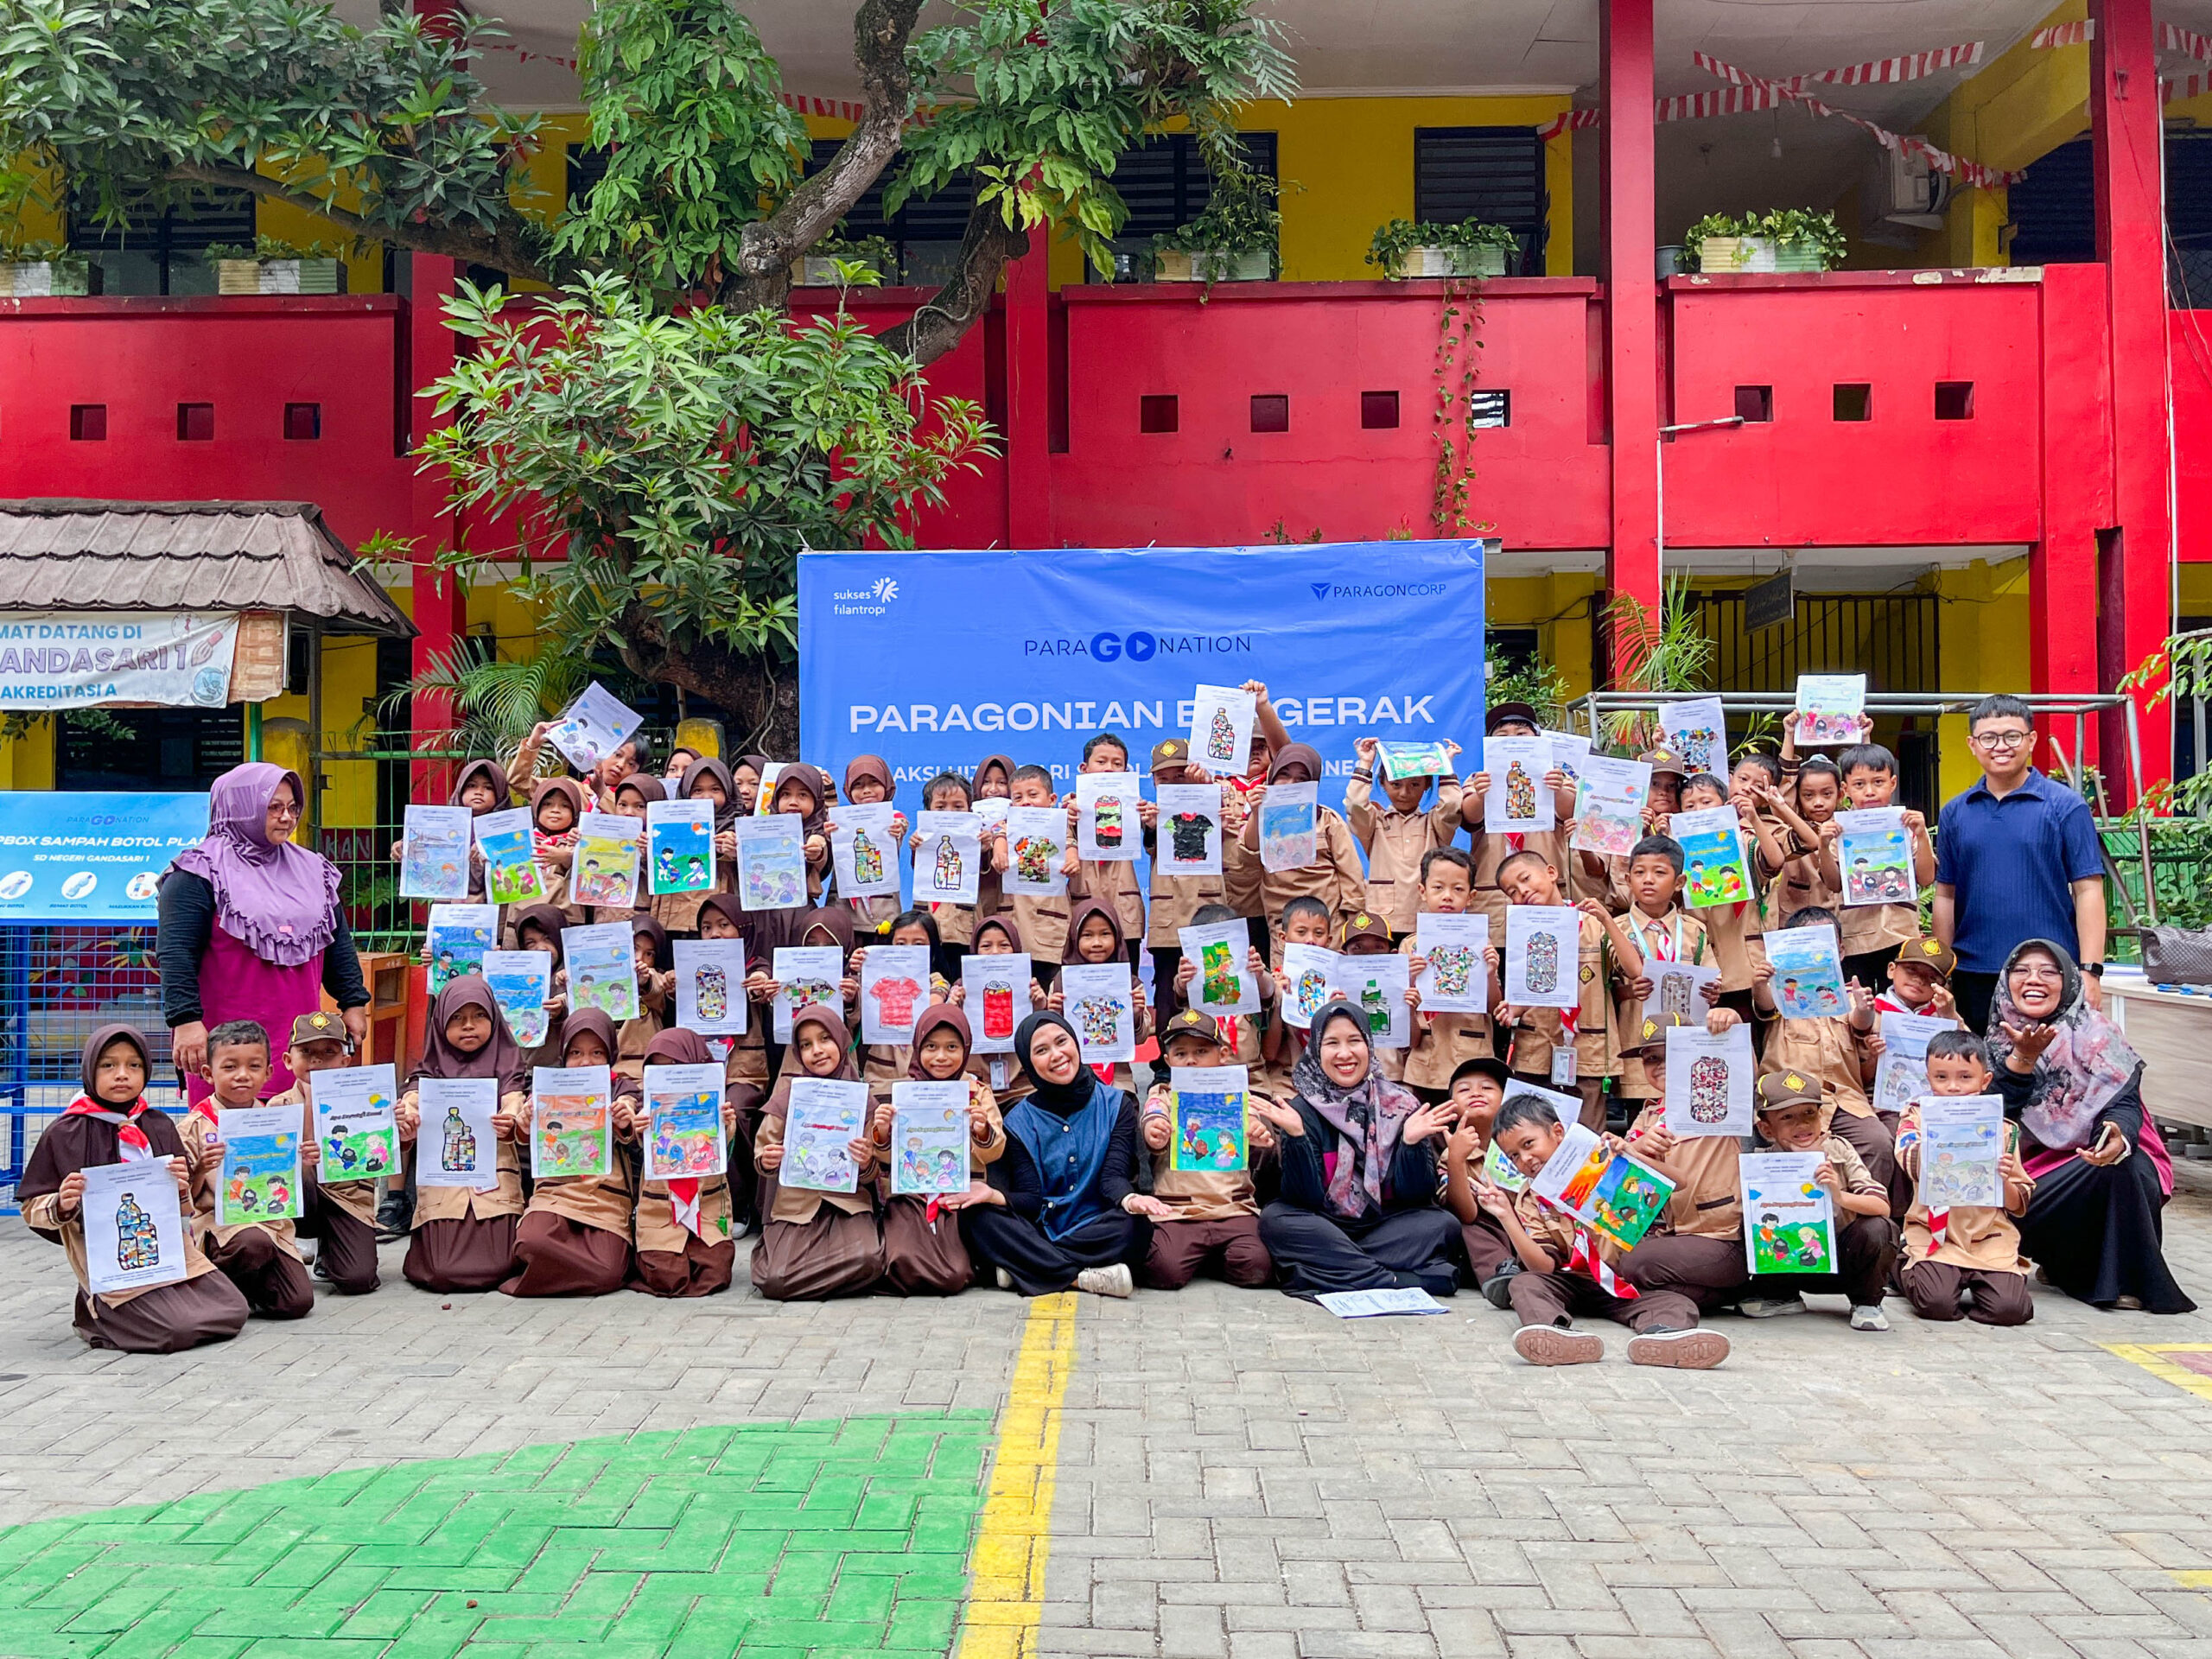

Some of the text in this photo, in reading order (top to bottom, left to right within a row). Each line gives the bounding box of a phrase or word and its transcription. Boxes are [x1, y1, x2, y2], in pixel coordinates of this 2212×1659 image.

[834, 589, 871, 600] sukses
[1334, 583, 1446, 598] PARAGONCORP
[834, 604, 886, 617] filantropi
[40, 625, 119, 639] DATANG
[124, 625, 142, 639] DI
[175, 644, 187, 671] 1
[1, 683, 118, 699] AKREDITASI A
[849, 701, 1163, 733] PARAGONIAN
[40, 836, 109, 847] SAMPAH
[111, 837, 163, 847] BOTOL
[87, 855, 144, 863] GANDASARI
